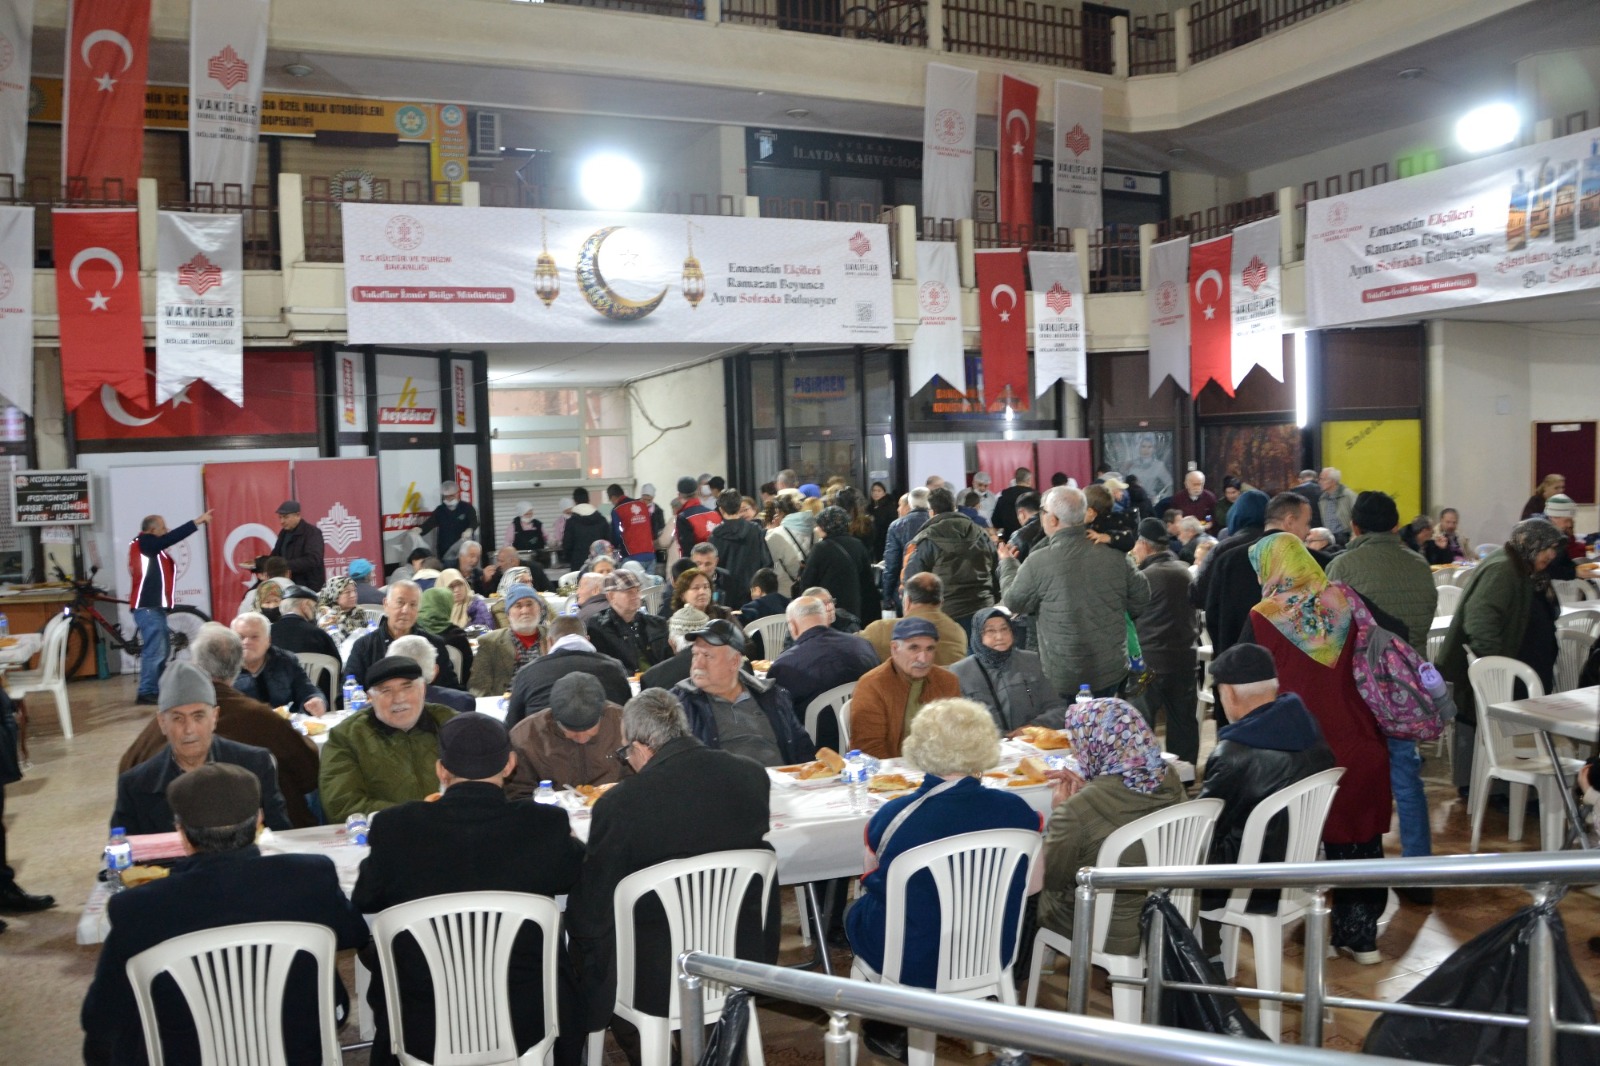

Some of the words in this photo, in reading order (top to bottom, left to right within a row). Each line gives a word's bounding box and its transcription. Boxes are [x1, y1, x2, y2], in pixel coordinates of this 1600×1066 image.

[196, 98, 258, 117] VAKIFLAR
[1368, 217, 1426, 239] Emanetin
[1364, 237, 1419, 257] Ramazan
[1420, 226, 1476, 248] Boyunca
[728, 262, 782, 274] Emanetin
[726, 277, 778, 290] Ramazan
[779, 278, 825, 292] Boyunca
[738, 292, 782, 304] Sofrada
[165, 306, 234, 318] VAKIFLAR
[381, 408, 434, 424] heydöner
[26, 492, 79, 502] FOTOKOPİ
[21, 513, 49, 522] FAKS
